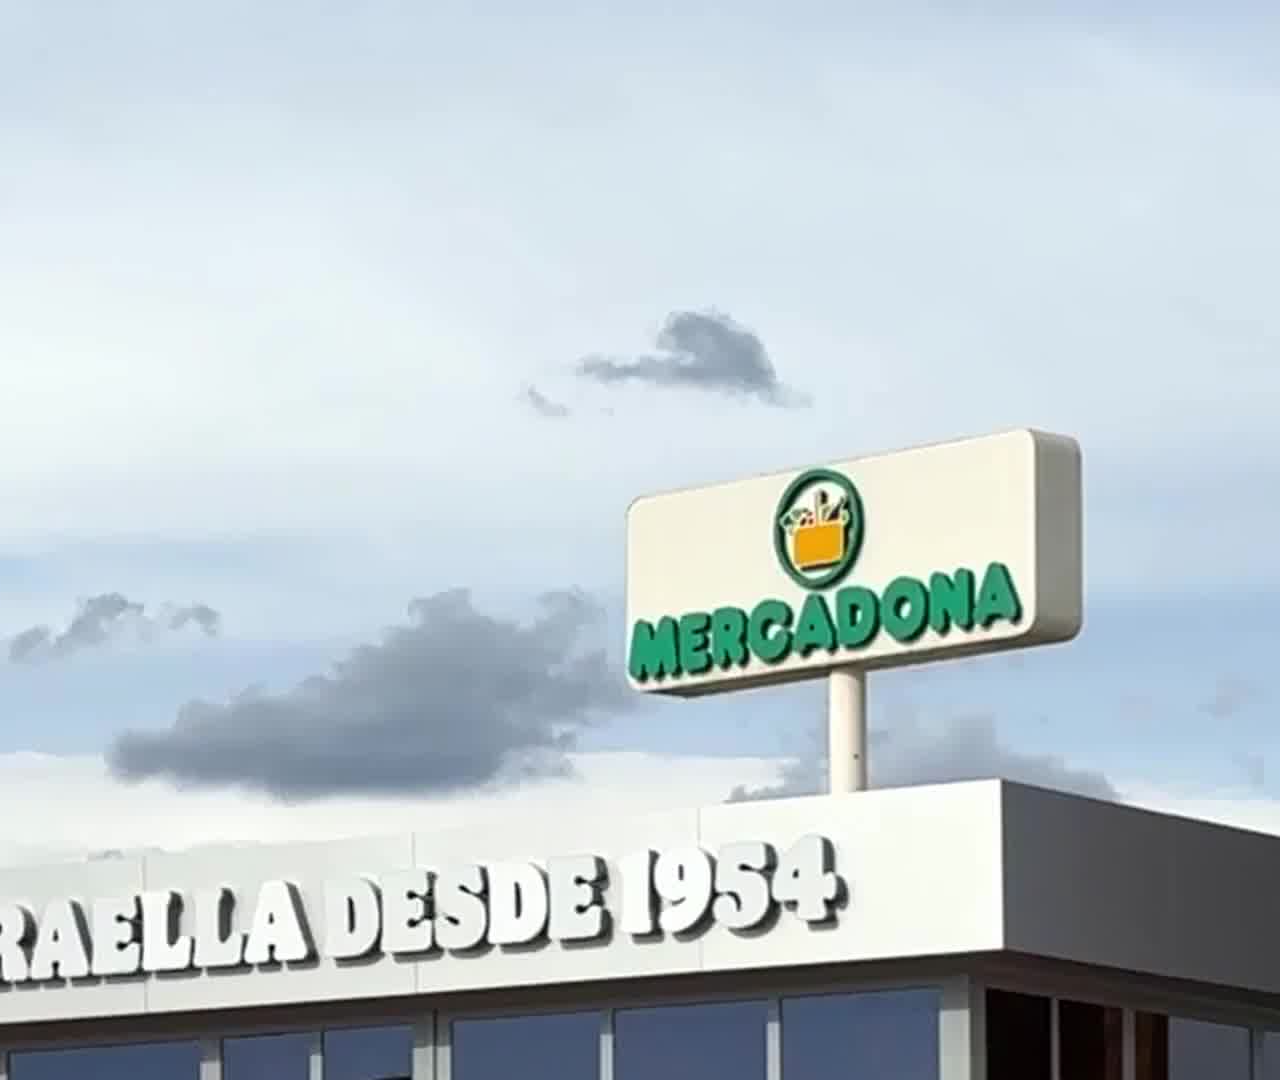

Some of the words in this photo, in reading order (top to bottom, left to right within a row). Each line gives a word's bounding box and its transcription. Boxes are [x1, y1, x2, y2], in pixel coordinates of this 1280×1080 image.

[629, 562, 1021, 681] MERCADONA
[323, 854, 612, 967] DESDE
[620, 834, 847, 943] 1954
